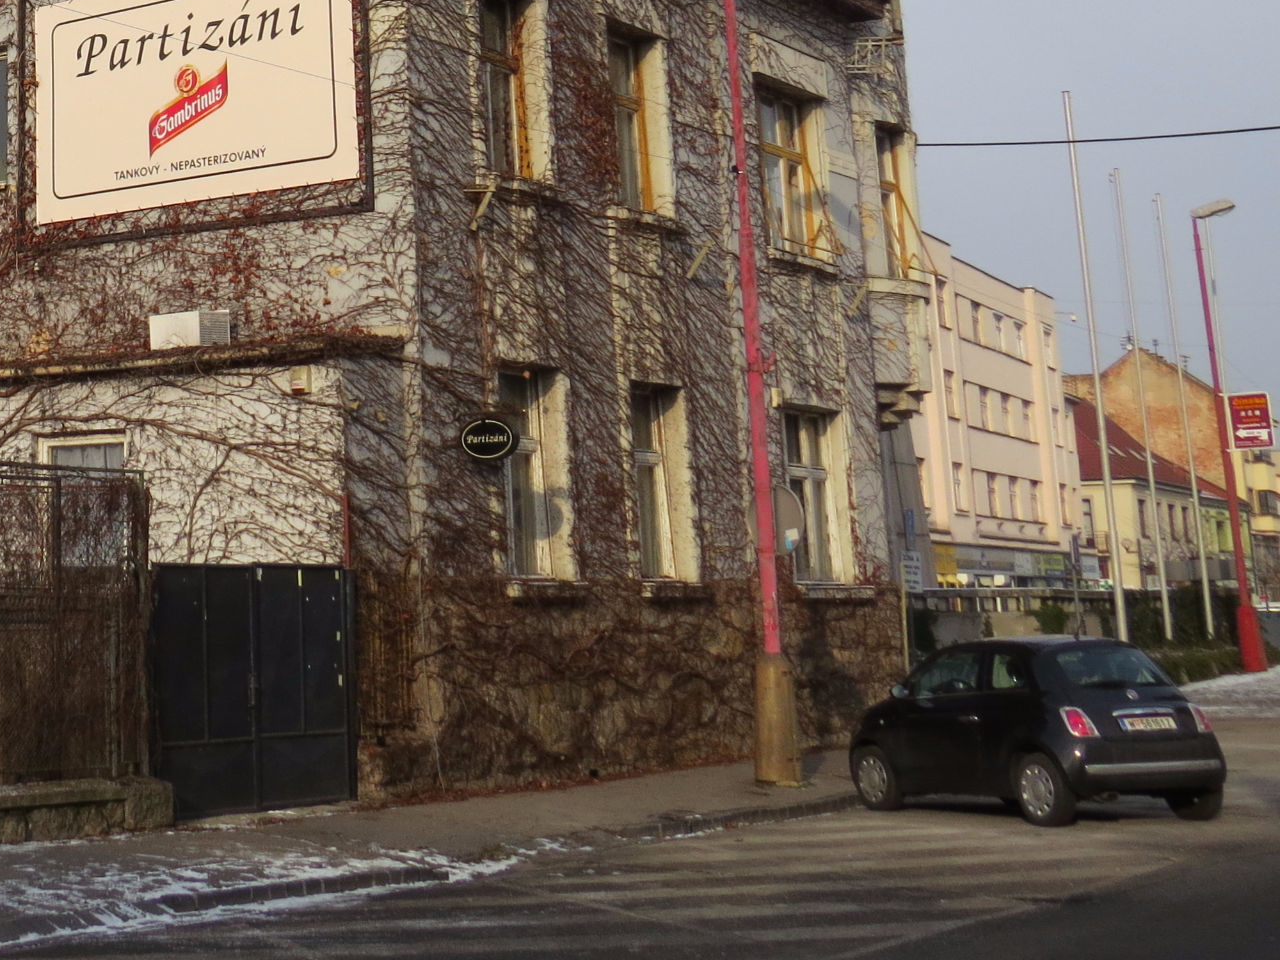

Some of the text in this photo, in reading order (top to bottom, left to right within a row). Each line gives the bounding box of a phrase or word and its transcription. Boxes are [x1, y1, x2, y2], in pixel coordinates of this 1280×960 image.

[152, 84, 223, 139] Gambrinus
[114, 162, 160, 181] TANKOVÝ
[170, 147, 267, 173] NEPASTERIZOVANÝ
[466, 433, 508, 444] Partizáni
